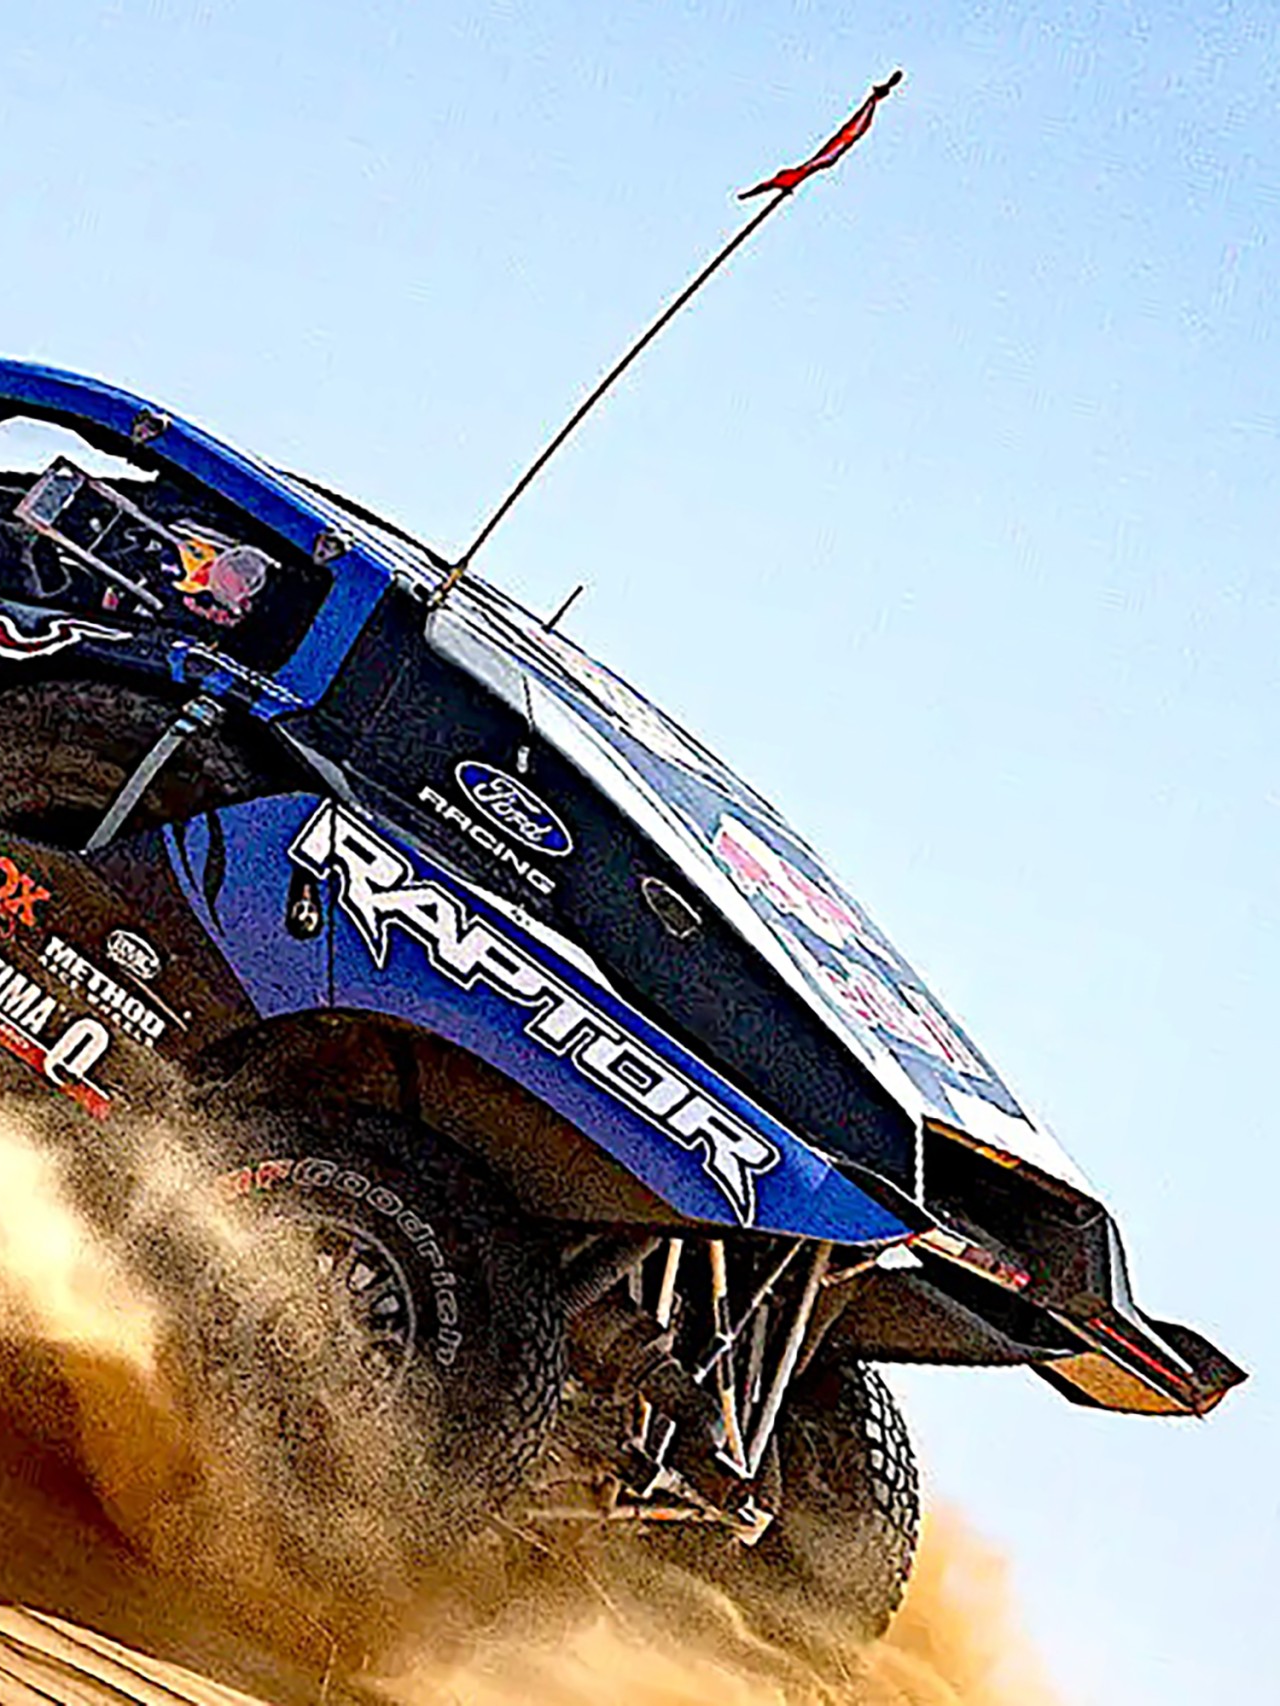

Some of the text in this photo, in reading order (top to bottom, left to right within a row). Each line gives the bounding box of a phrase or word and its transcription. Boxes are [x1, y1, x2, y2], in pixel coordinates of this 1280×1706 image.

[417, 787, 556, 894] RACING
[471, 776, 554, 843] Ford
[44, 935, 166, 1039] METHOD
[288, 797, 781, 1228] RAPTOR
